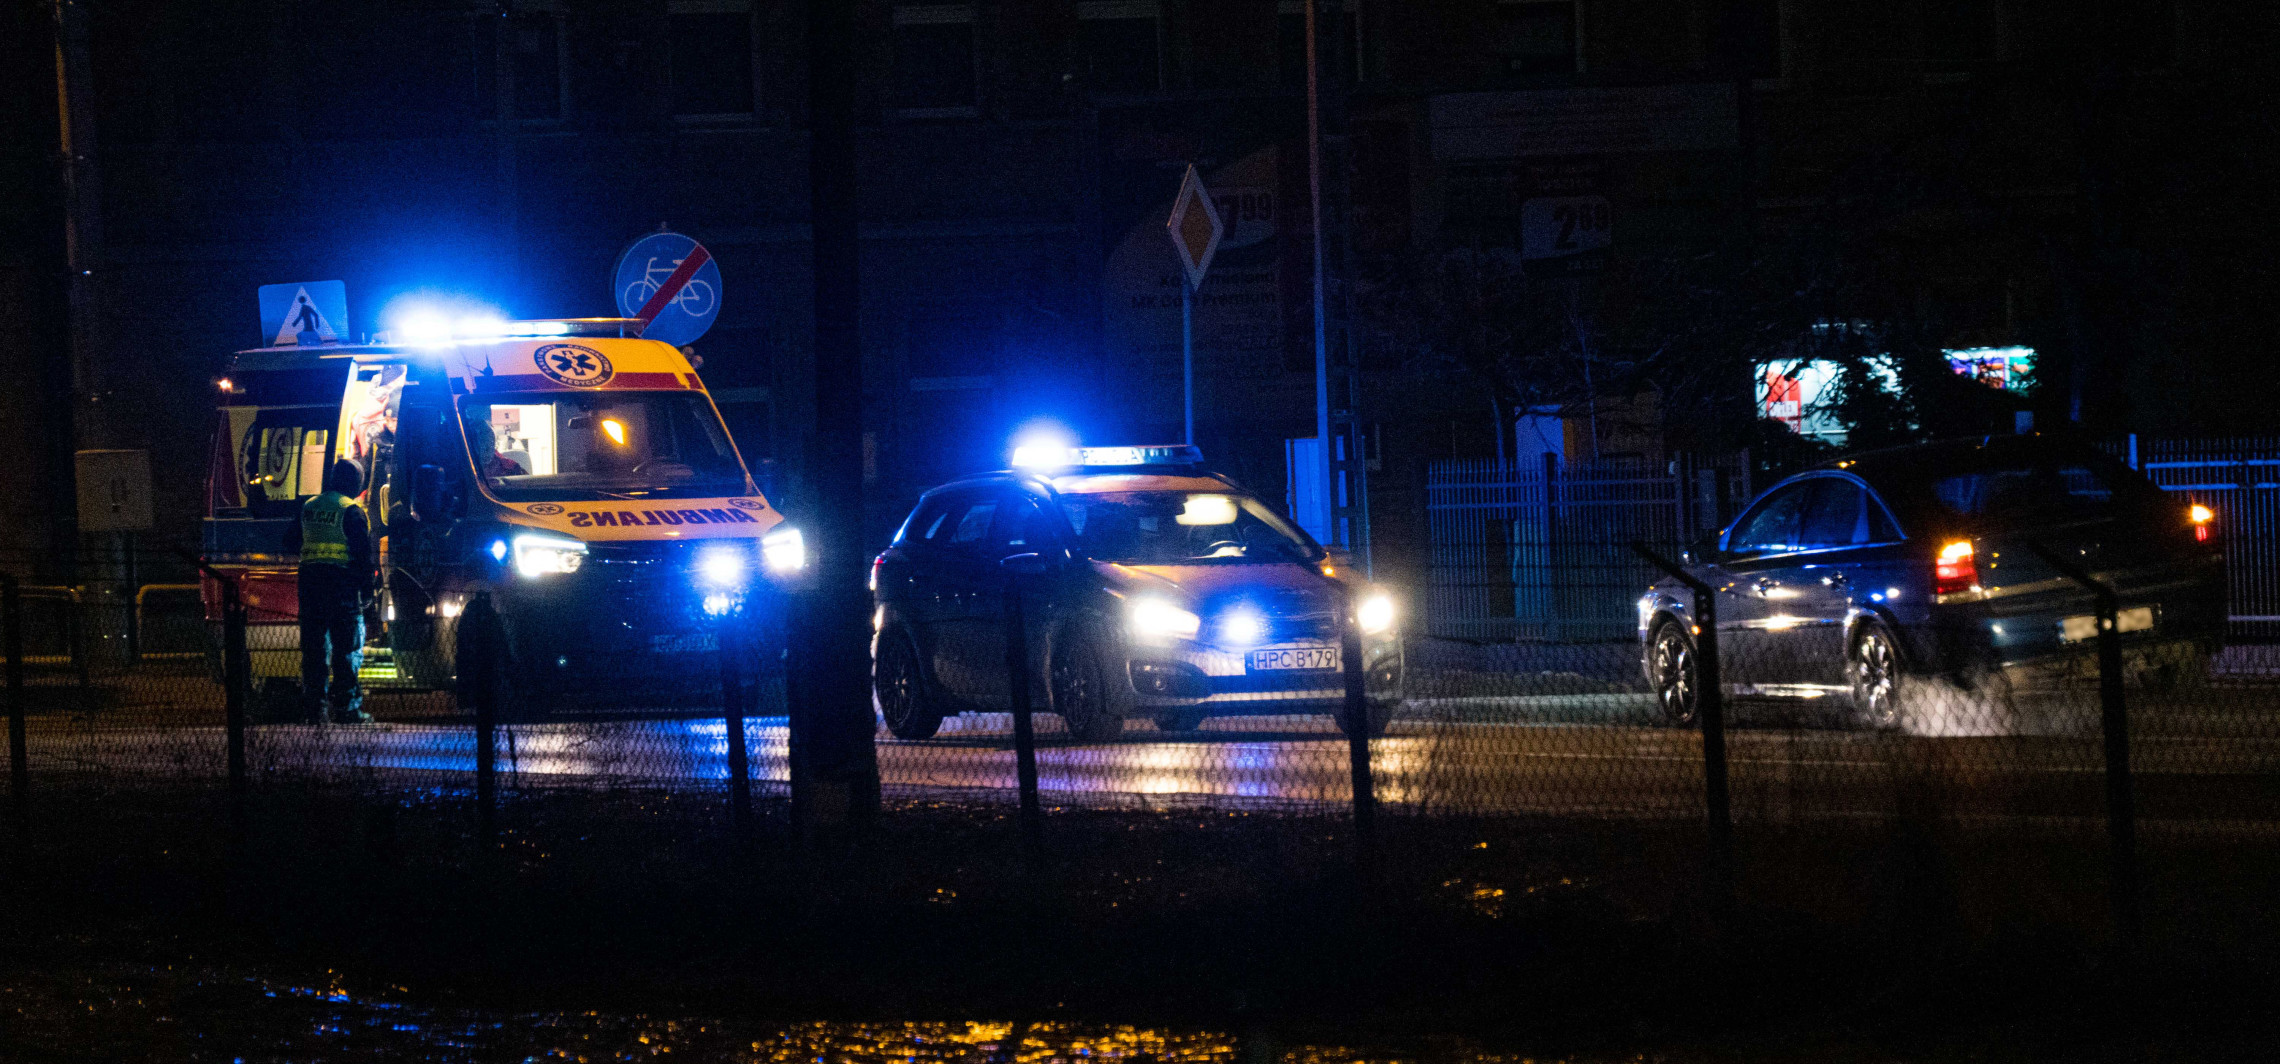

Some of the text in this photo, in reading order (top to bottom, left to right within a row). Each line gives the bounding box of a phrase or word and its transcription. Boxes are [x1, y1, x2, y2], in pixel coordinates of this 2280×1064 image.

[1202, 292, 1277, 306] Premium
[560, 375, 606, 386] MEDYCZNE
[1256, 650, 1333, 669] HPC B179
